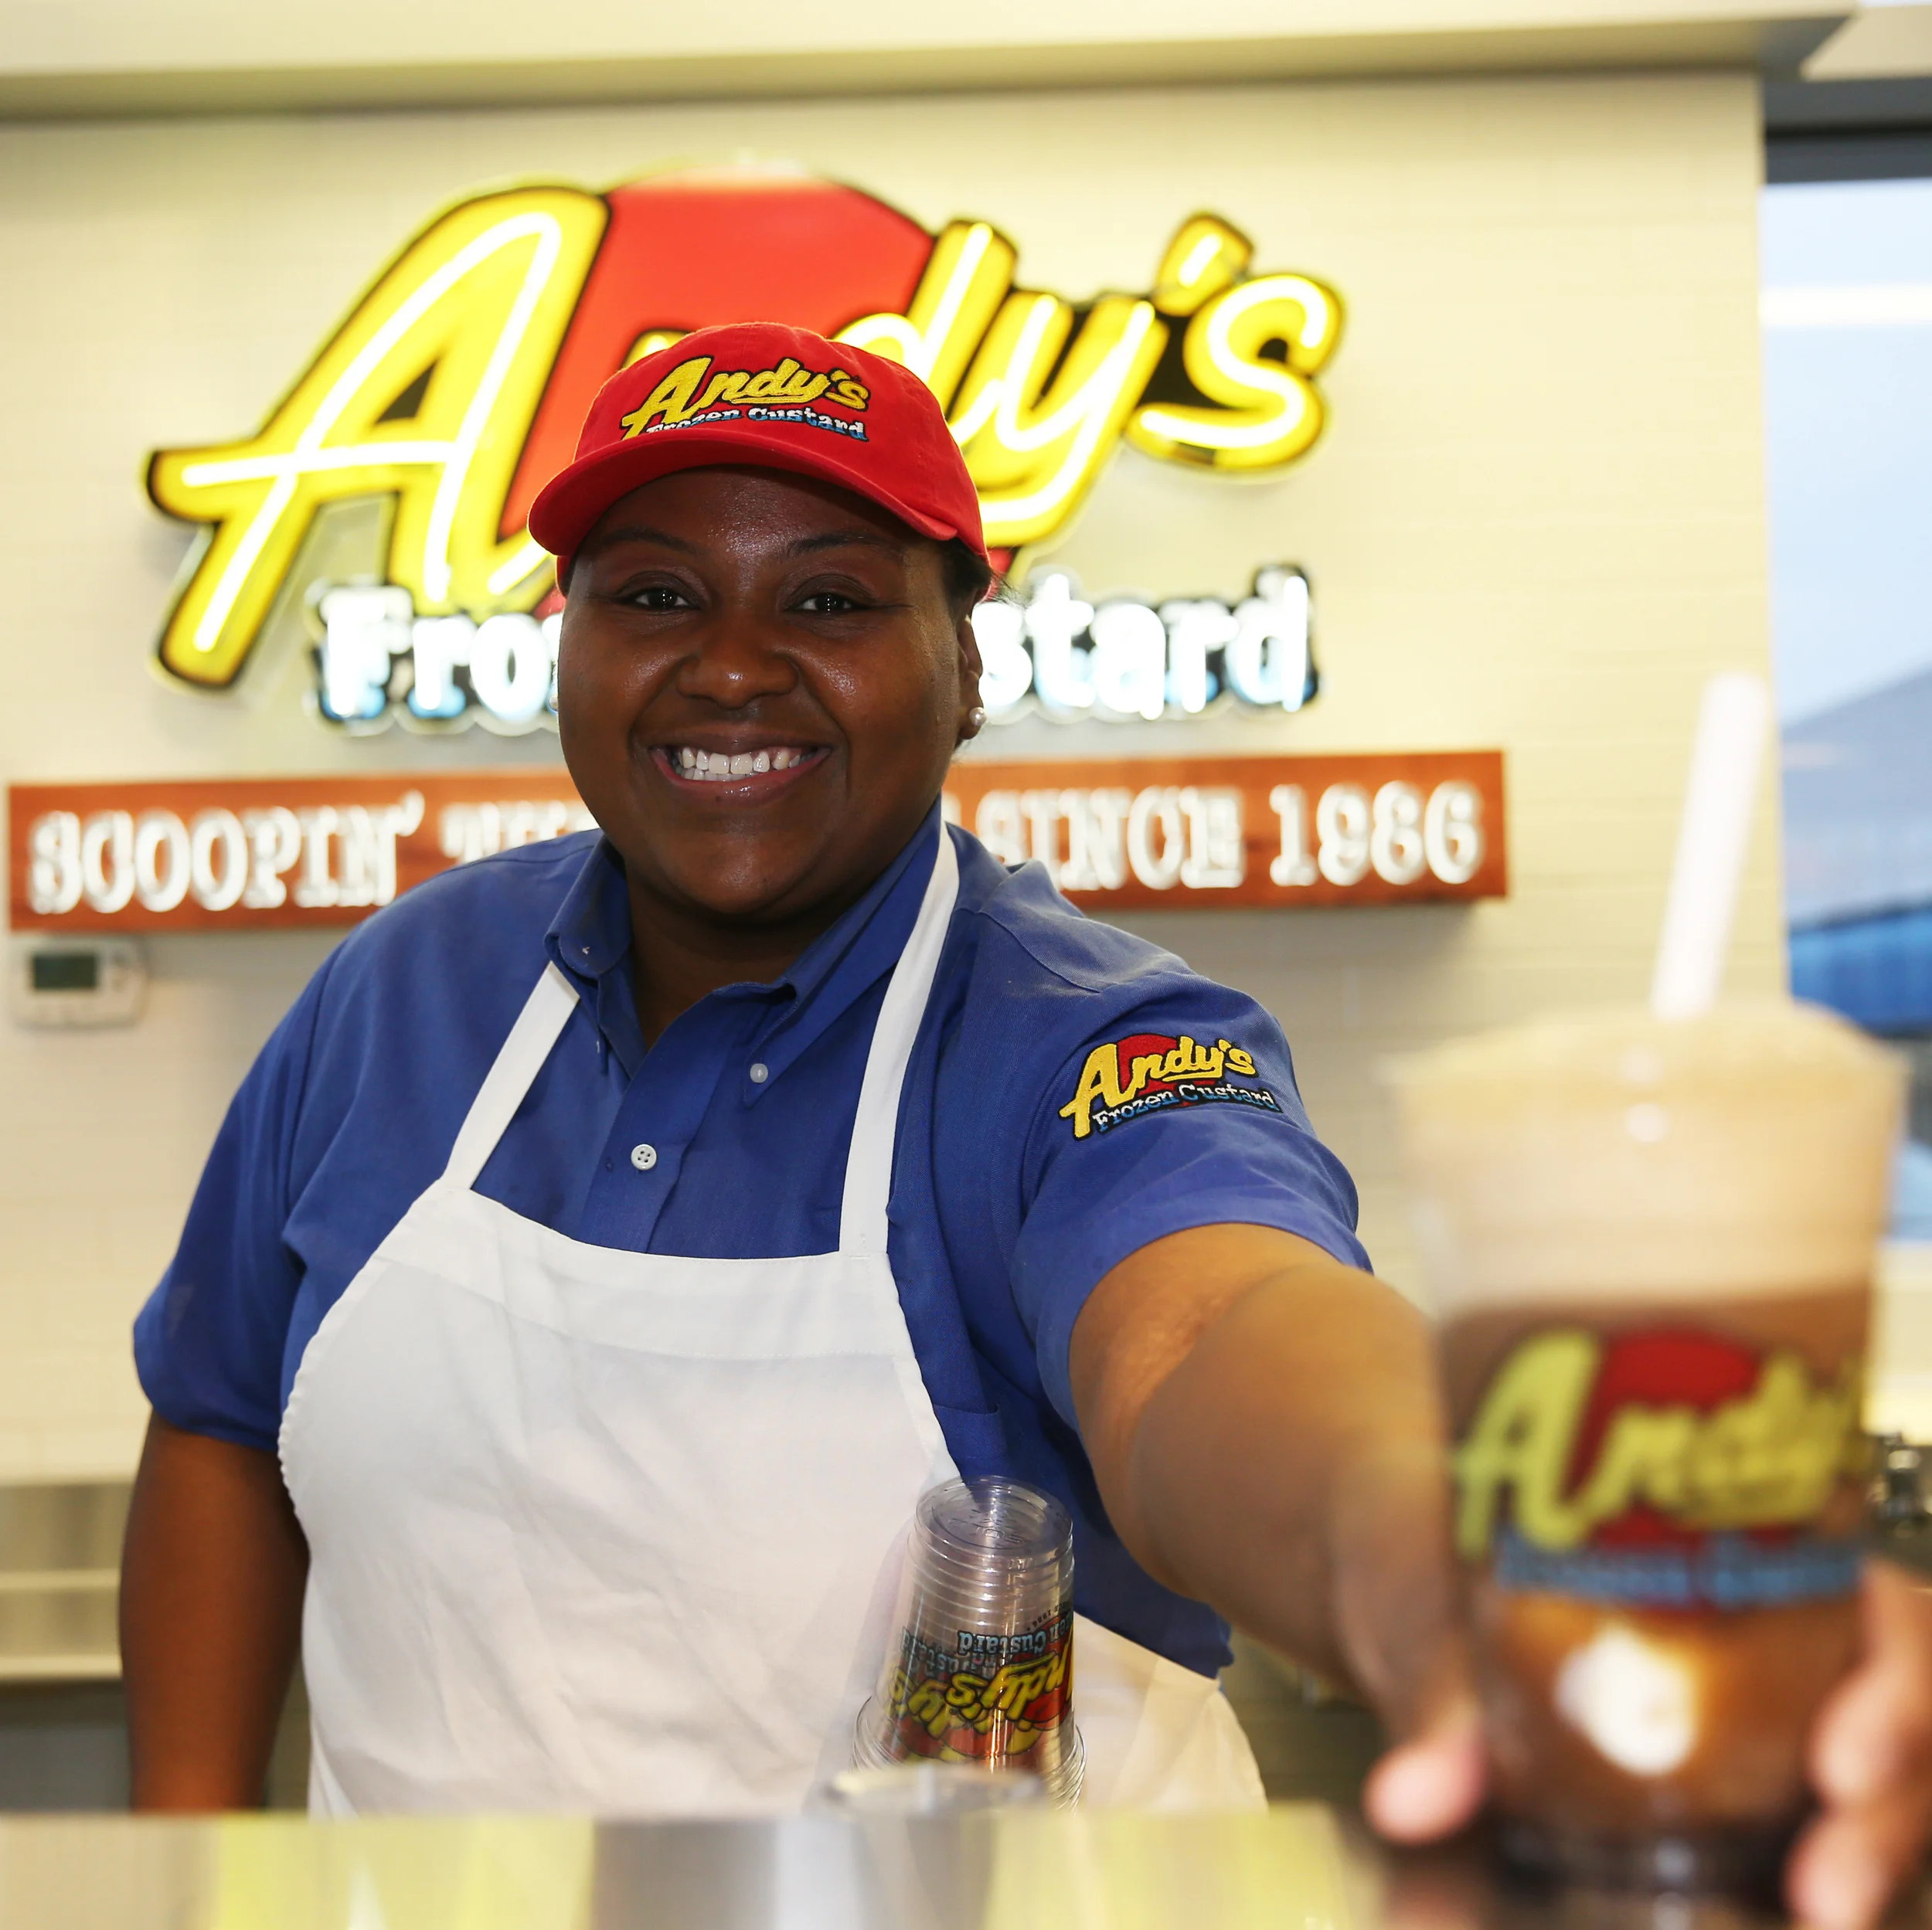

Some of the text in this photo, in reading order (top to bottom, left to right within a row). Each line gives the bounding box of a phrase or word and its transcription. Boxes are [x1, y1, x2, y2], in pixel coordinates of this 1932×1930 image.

[620, 355, 871, 440] Andy's
[747, 406, 870, 443] Custard
[315, 583, 558, 730] Fro
[28, 788, 426, 915] SCOOPIN'
[1268, 779, 1485, 887] 1986
[1057, 1035, 1260, 1142] Andy's
[1091, 1082, 1284, 1133] Frozen Custard
[957, 1629, 1047, 1656] Custard
